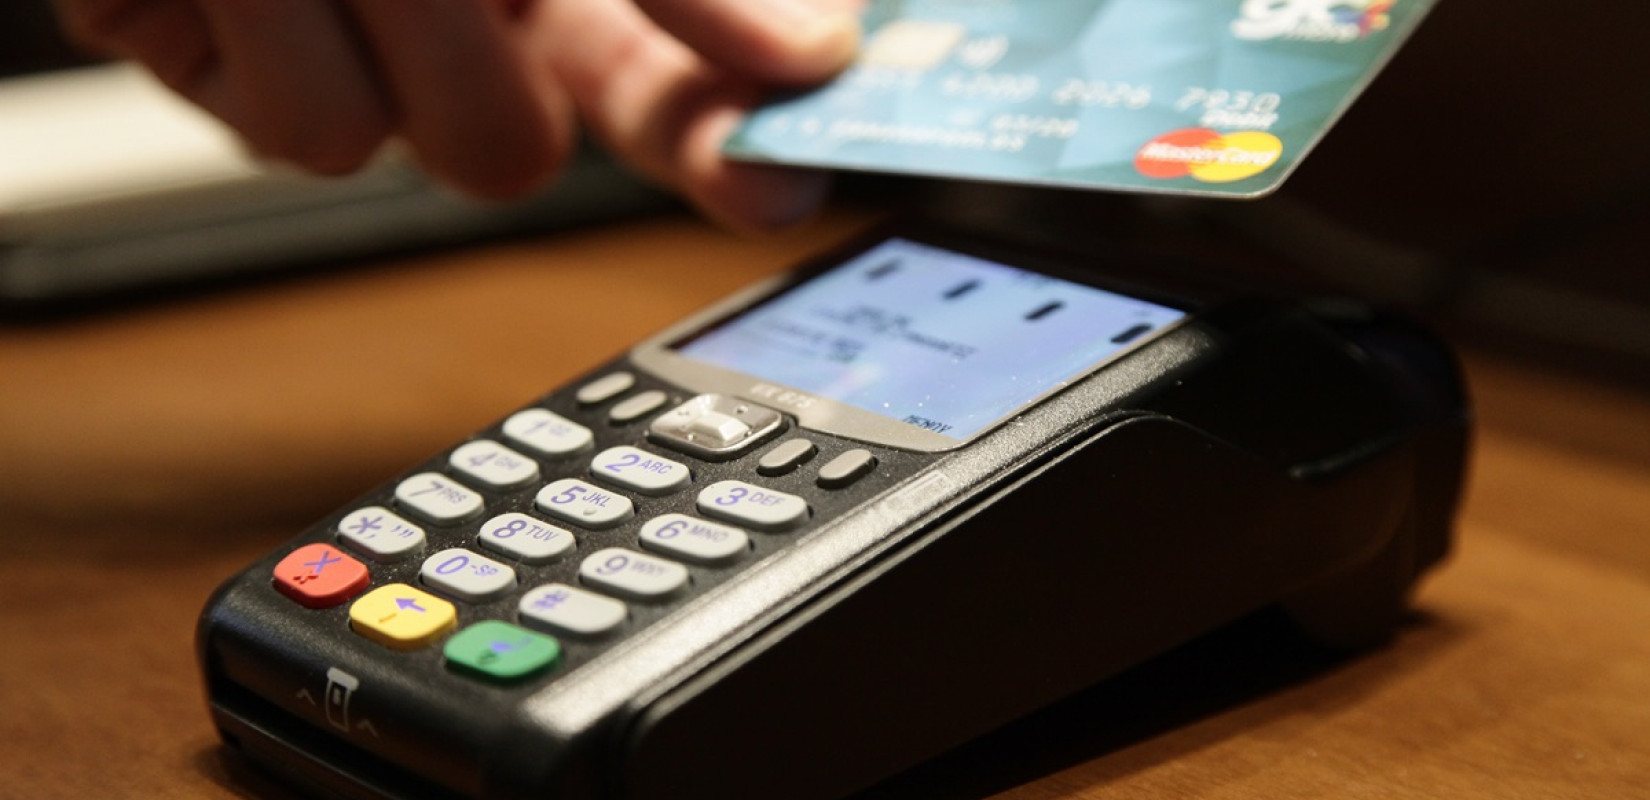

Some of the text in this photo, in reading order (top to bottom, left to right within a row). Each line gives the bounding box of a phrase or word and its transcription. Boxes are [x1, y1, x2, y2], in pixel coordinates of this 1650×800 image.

[1140, 141, 1277, 166] MasterCard
[469, 451, 499, 467] 4
[605, 454, 673, 475] 2 ABC
[409, 480, 444, 497] 7
[551, 485, 613, 508] 5 JKL
[715, 487, 786, 507] 3 DEF
[492, 519, 560, 541] 8 TUV
[655, 520, 729, 542] 6 MNO
[436, 555, 470, 575] 0
[595, 555, 629, 575] 9
